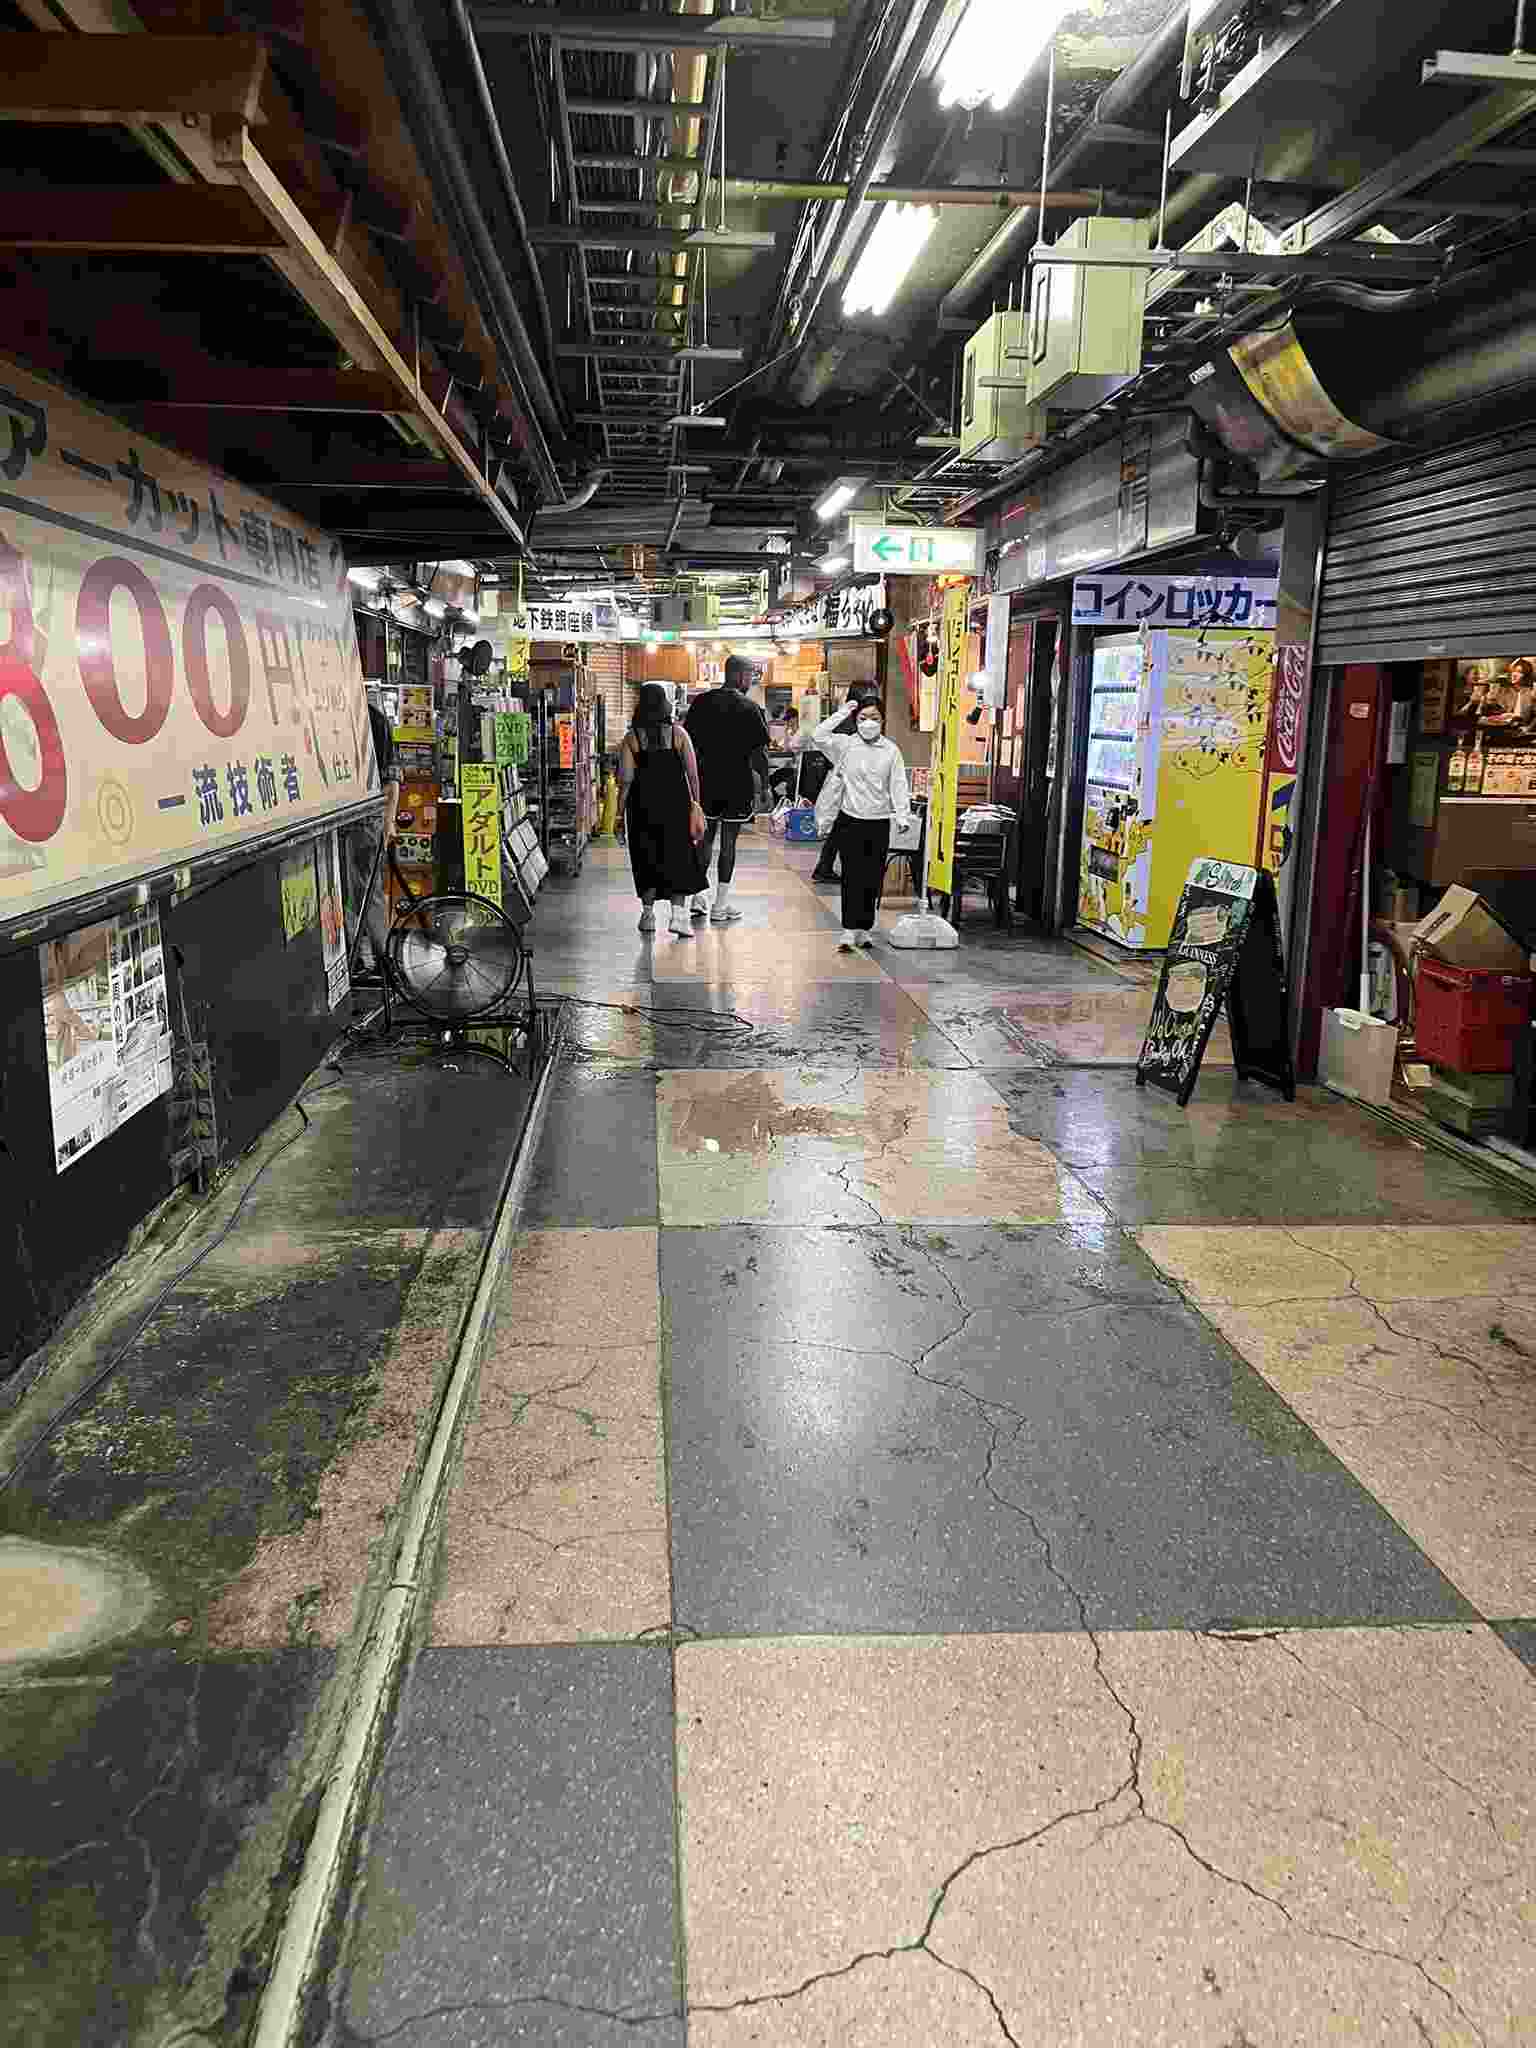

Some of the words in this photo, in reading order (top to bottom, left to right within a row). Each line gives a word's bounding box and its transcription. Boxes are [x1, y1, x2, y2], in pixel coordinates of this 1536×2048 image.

[1074, 580, 1277, 621] コインロッカー
[157, 750, 303, 827] 一流技術者
[466, 788, 498, 879] アダルト
